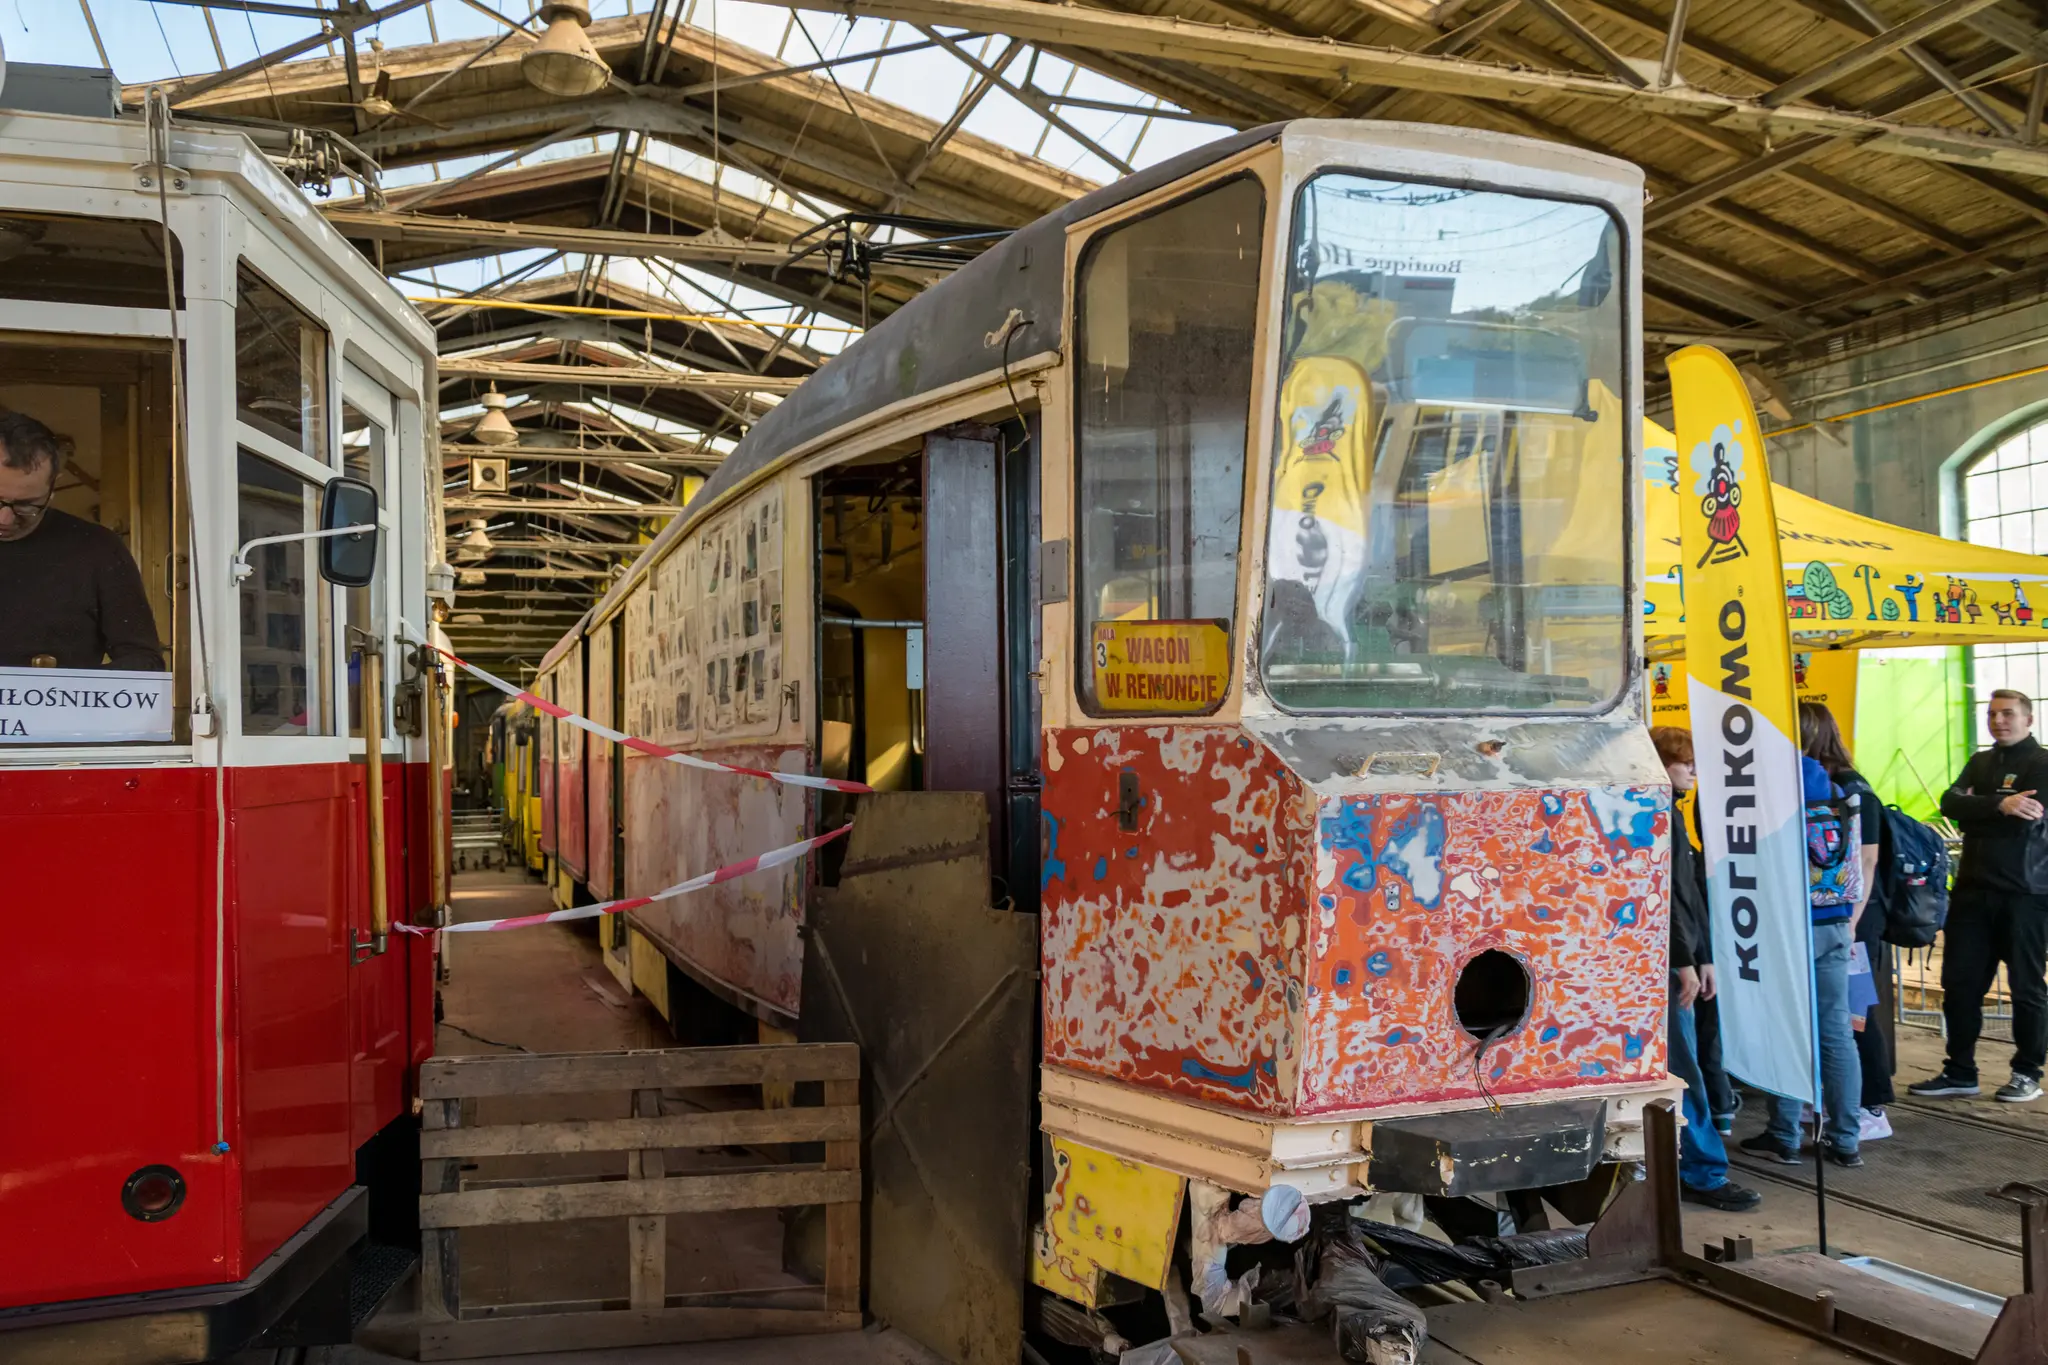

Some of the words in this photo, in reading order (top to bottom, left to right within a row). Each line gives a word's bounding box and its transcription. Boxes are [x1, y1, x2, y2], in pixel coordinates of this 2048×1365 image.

[1096, 642, 1107, 668] 3
[1126, 637, 1190, 665] WAGON
[1105, 672, 1120, 699] W
[1126, 673, 1218, 703] REMONCIE
